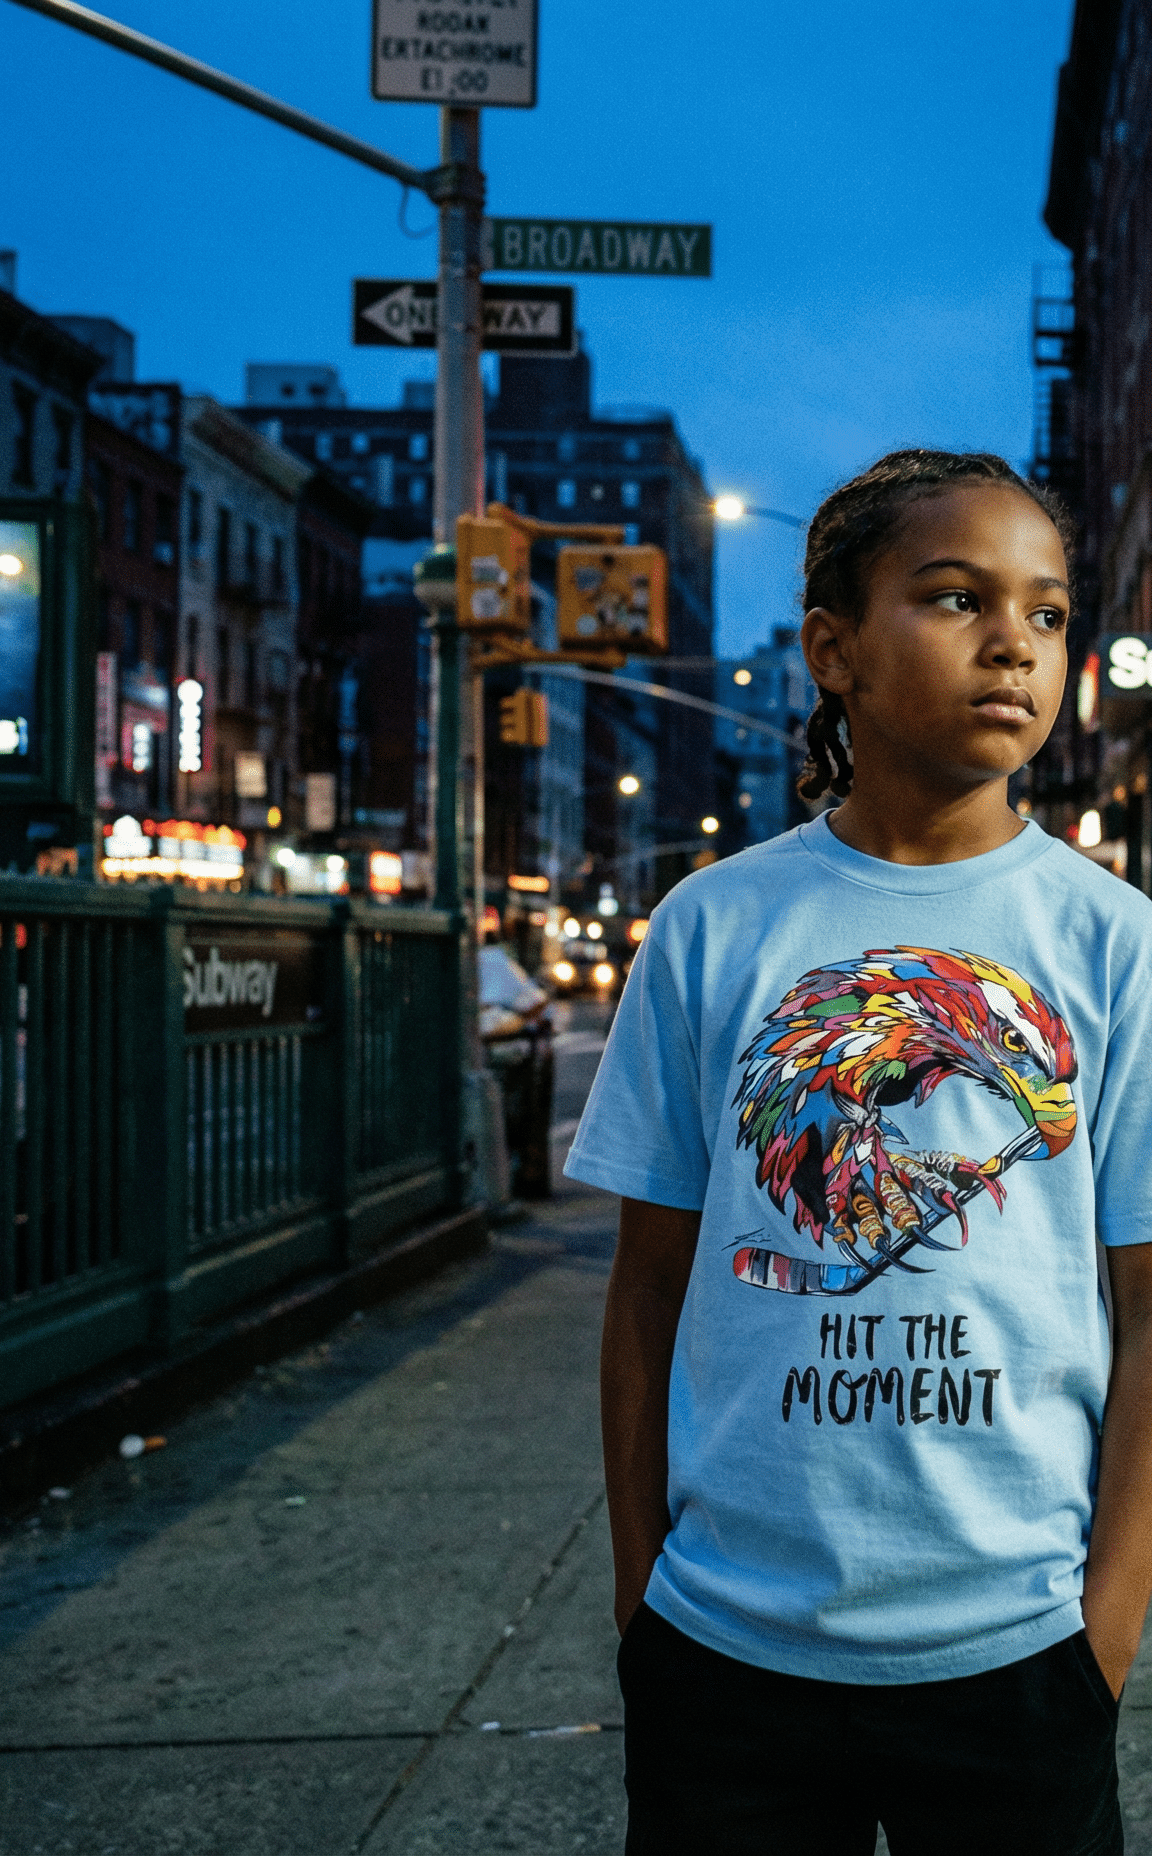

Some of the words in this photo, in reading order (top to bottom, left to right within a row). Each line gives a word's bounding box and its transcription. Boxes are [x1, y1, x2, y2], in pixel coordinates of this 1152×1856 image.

[503, 225, 699, 270] BROADWAY
[384, 301, 438, 329] ON
[820, 1313, 885, 1361] HIT
[898, 1313, 972, 1361] THE
[782, 1366, 1002, 1427] MOMENT
